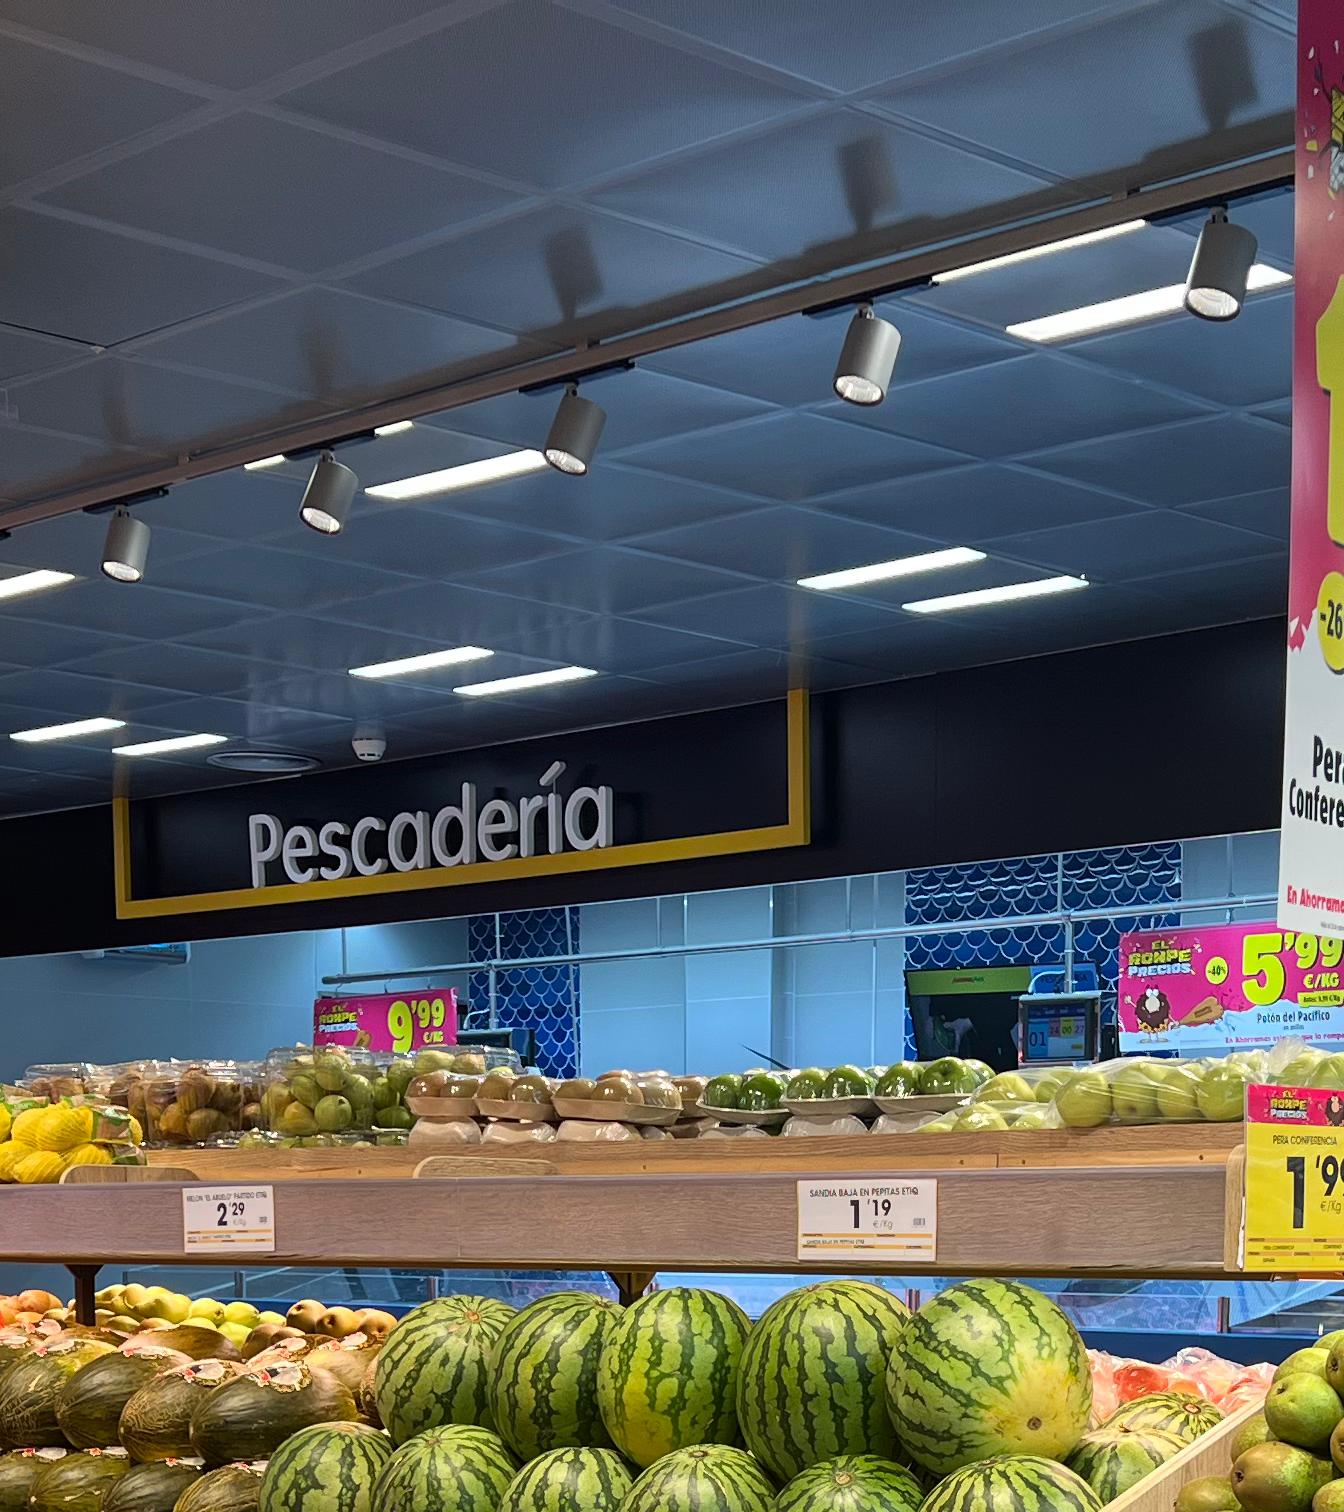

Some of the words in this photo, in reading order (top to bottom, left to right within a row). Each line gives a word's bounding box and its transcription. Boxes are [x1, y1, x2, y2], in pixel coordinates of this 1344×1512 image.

[249, 761, 614, 889] Pescadería
[1287, 884, 1298, 906] En
[1152, 940, 1171, 951] EL
[1128, 948, 1193, 966] ROMPE
[1128, 963, 1193, 977] PRECIOS
[1283, 1011, 1296, 1022] del
[1030, 1032, 1046, 1046] 01
[1272, 1134, 1289, 1145] PERA
[1290, 1135, 1338, 1146] CONFERENCIA
[809, 1189, 837, 1198] SANDIA
[838, 1188, 858, 1197] BAJA
[860, 1188, 870, 1196] EN
[871, 1187, 900, 1196] PEPITAS
[901, 1186, 919, 1196] ETIQ
